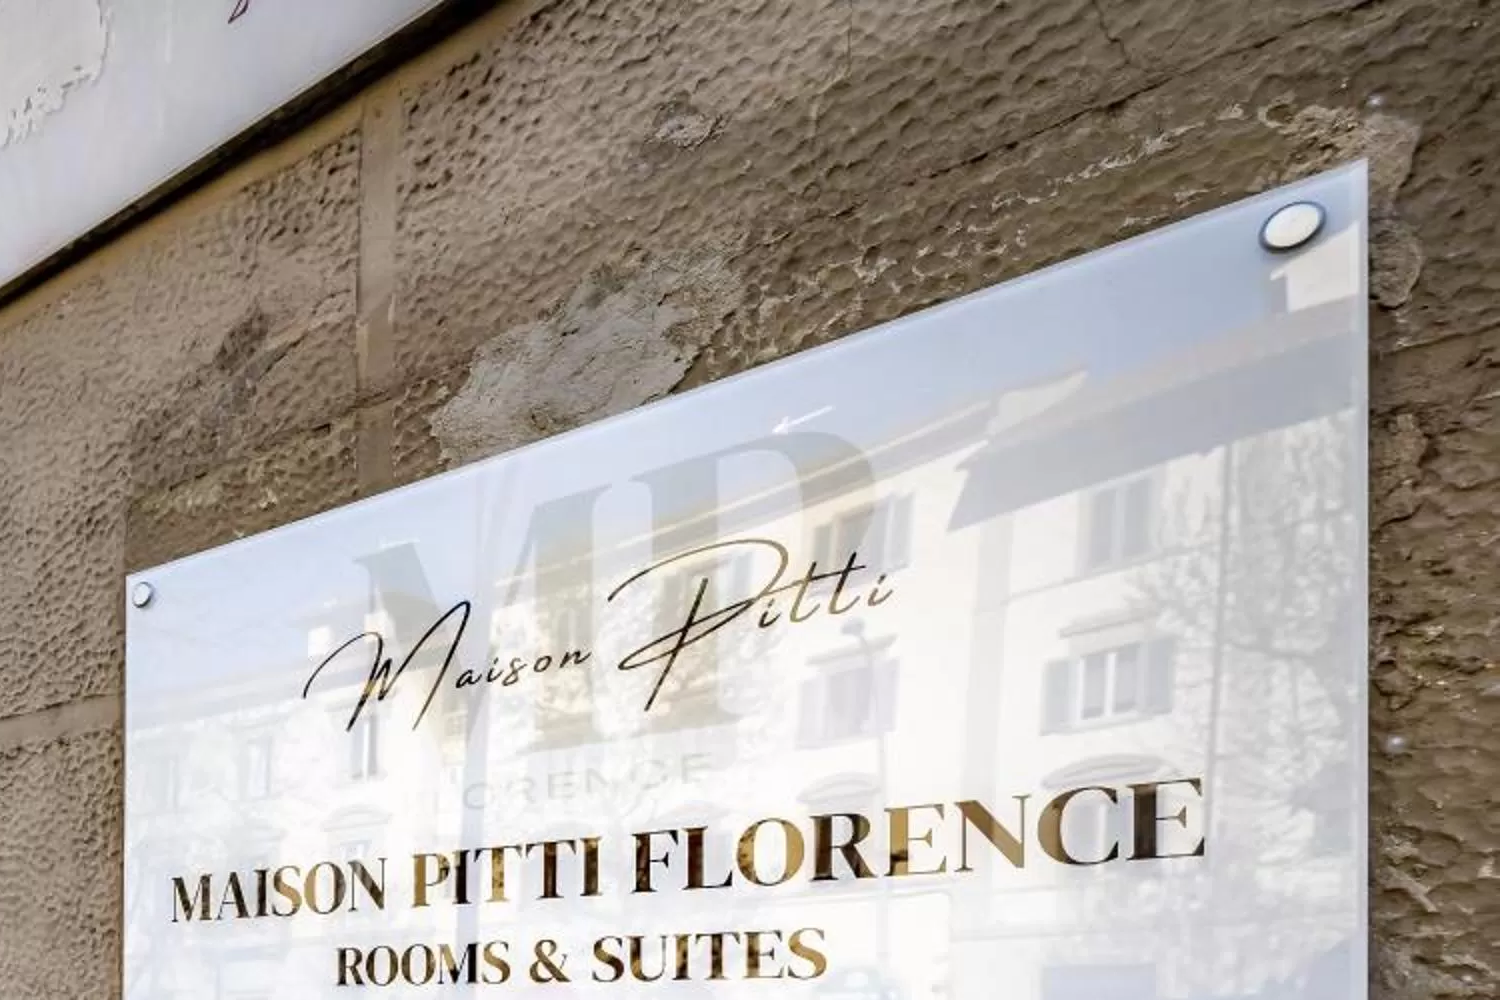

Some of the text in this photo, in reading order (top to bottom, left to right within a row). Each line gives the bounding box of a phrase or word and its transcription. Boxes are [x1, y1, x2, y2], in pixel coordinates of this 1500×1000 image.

[302, 538, 895, 732] Maison Pitti
[171, 777, 1206, 923] MAISON PITTI FLORENCE
[336, 928, 828, 987] ROOMS & SUITES
